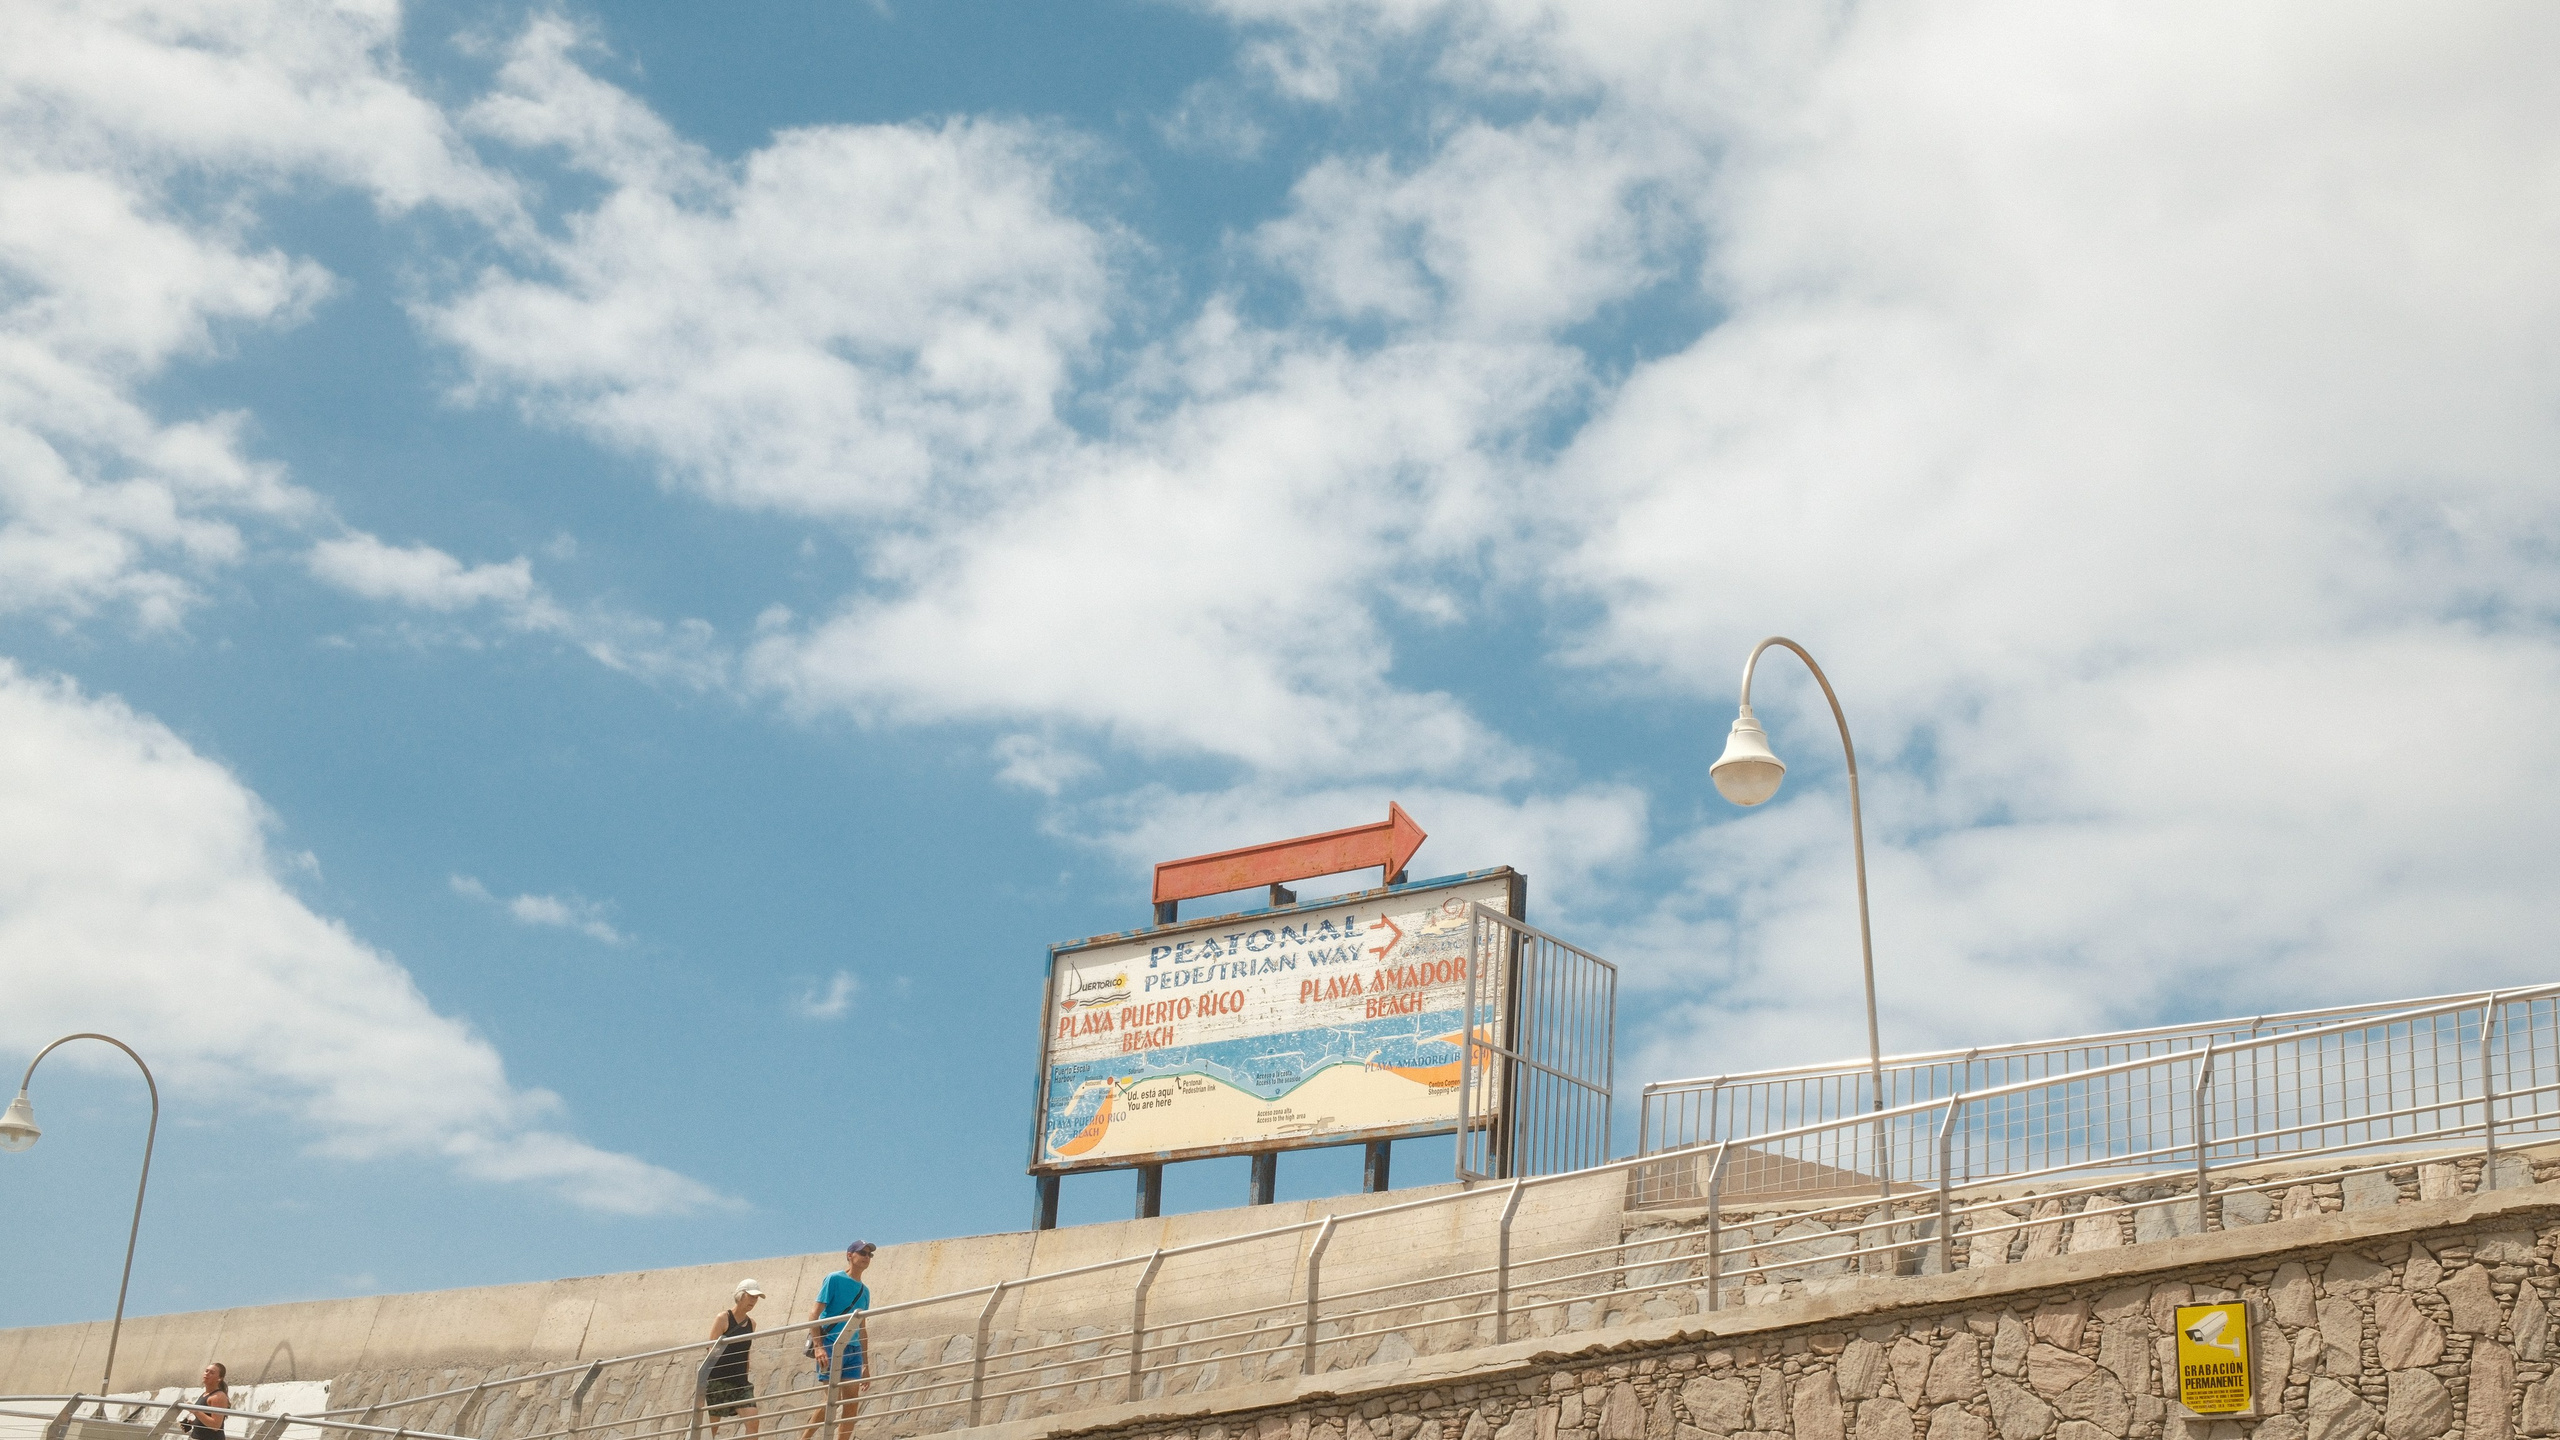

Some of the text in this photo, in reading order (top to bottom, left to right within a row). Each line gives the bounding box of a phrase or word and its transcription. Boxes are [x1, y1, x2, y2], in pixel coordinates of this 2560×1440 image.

[1149, 914, 1363, 968] PEATONAL
[1144, 952, 1297, 992] PEDESTRIAN
[1308, 941, 1364, 967] WAY
[1300, 973, 1363, 1004] PLAYA
[1058, 990, 1245, 1039] PLAYA PUERTO RICO
[1366, 992, 1424, 1019] BEACH
[1122, 1026, 1174, 1053] BEACH
[1365, 1062, 1393, 1073] PLAYA
[1396, 1055, 1448, 1069] AMADORES
[1127, 1090, 1139, 1101] Ud.
[1141, 1088, 1156, 1099] está
[1158, 1085, 1174, 1098] aquí
[1128, 1098, 1172, 1111] You are here
[1074, 1114, 1104, 1127] PUERTO
[1107, 1111, 1126, 1123] RICO
[1285, 1114, 1295, 1122] high
[2185, 1361, 2243, 1377] GRABACIÓN
[2185, 1375, 2244, 1390] PERMANENTE
